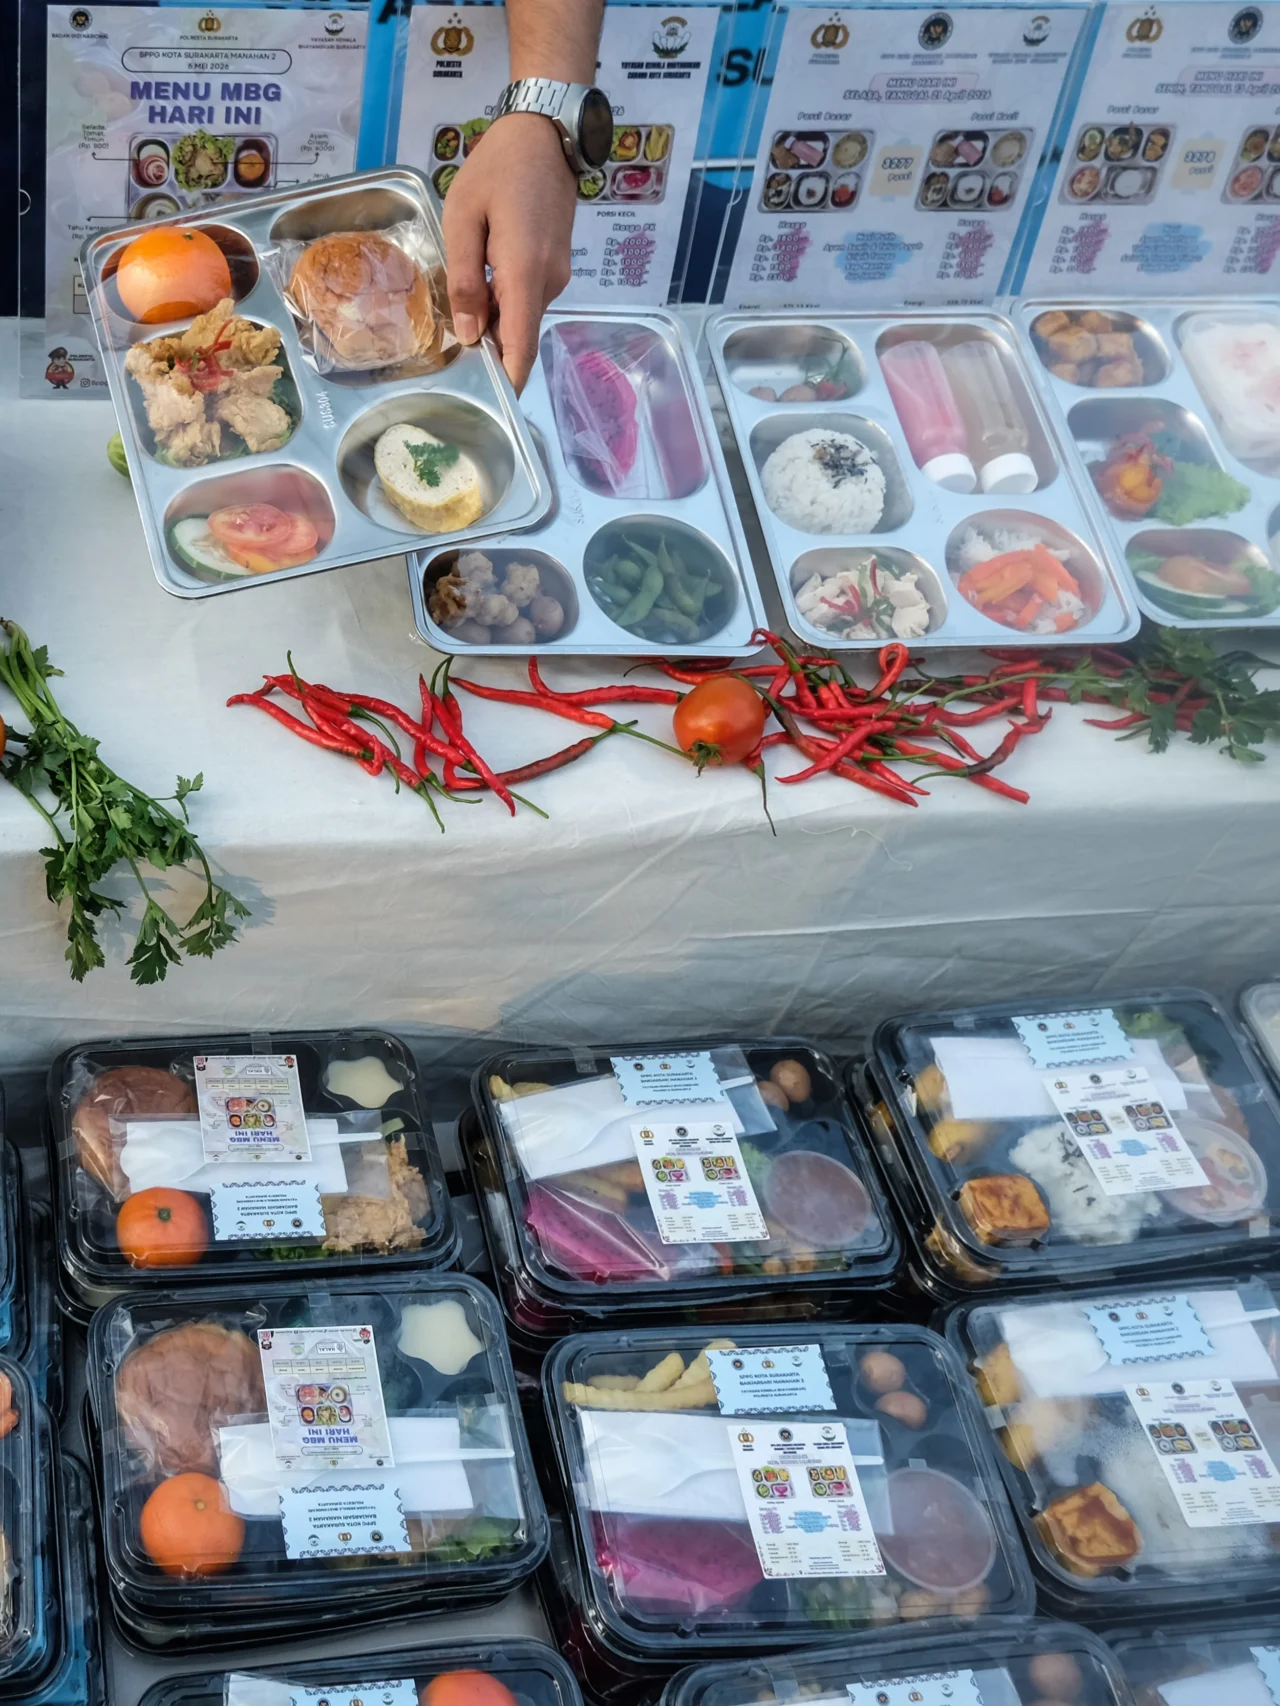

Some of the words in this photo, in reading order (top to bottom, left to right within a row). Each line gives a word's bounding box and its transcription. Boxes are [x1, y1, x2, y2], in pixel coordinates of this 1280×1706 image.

[162, 52, 182, 60] KOTA
[184, 52, 229, 61] SURAKARTA
[230, 53, 270, 61] MANAHAN
[130, 81, 212, 102] MENU
[220, 82, 282, 102] MBG
[148, 105, 215, 124] HARI
[224, 106, 262, 125] INI
